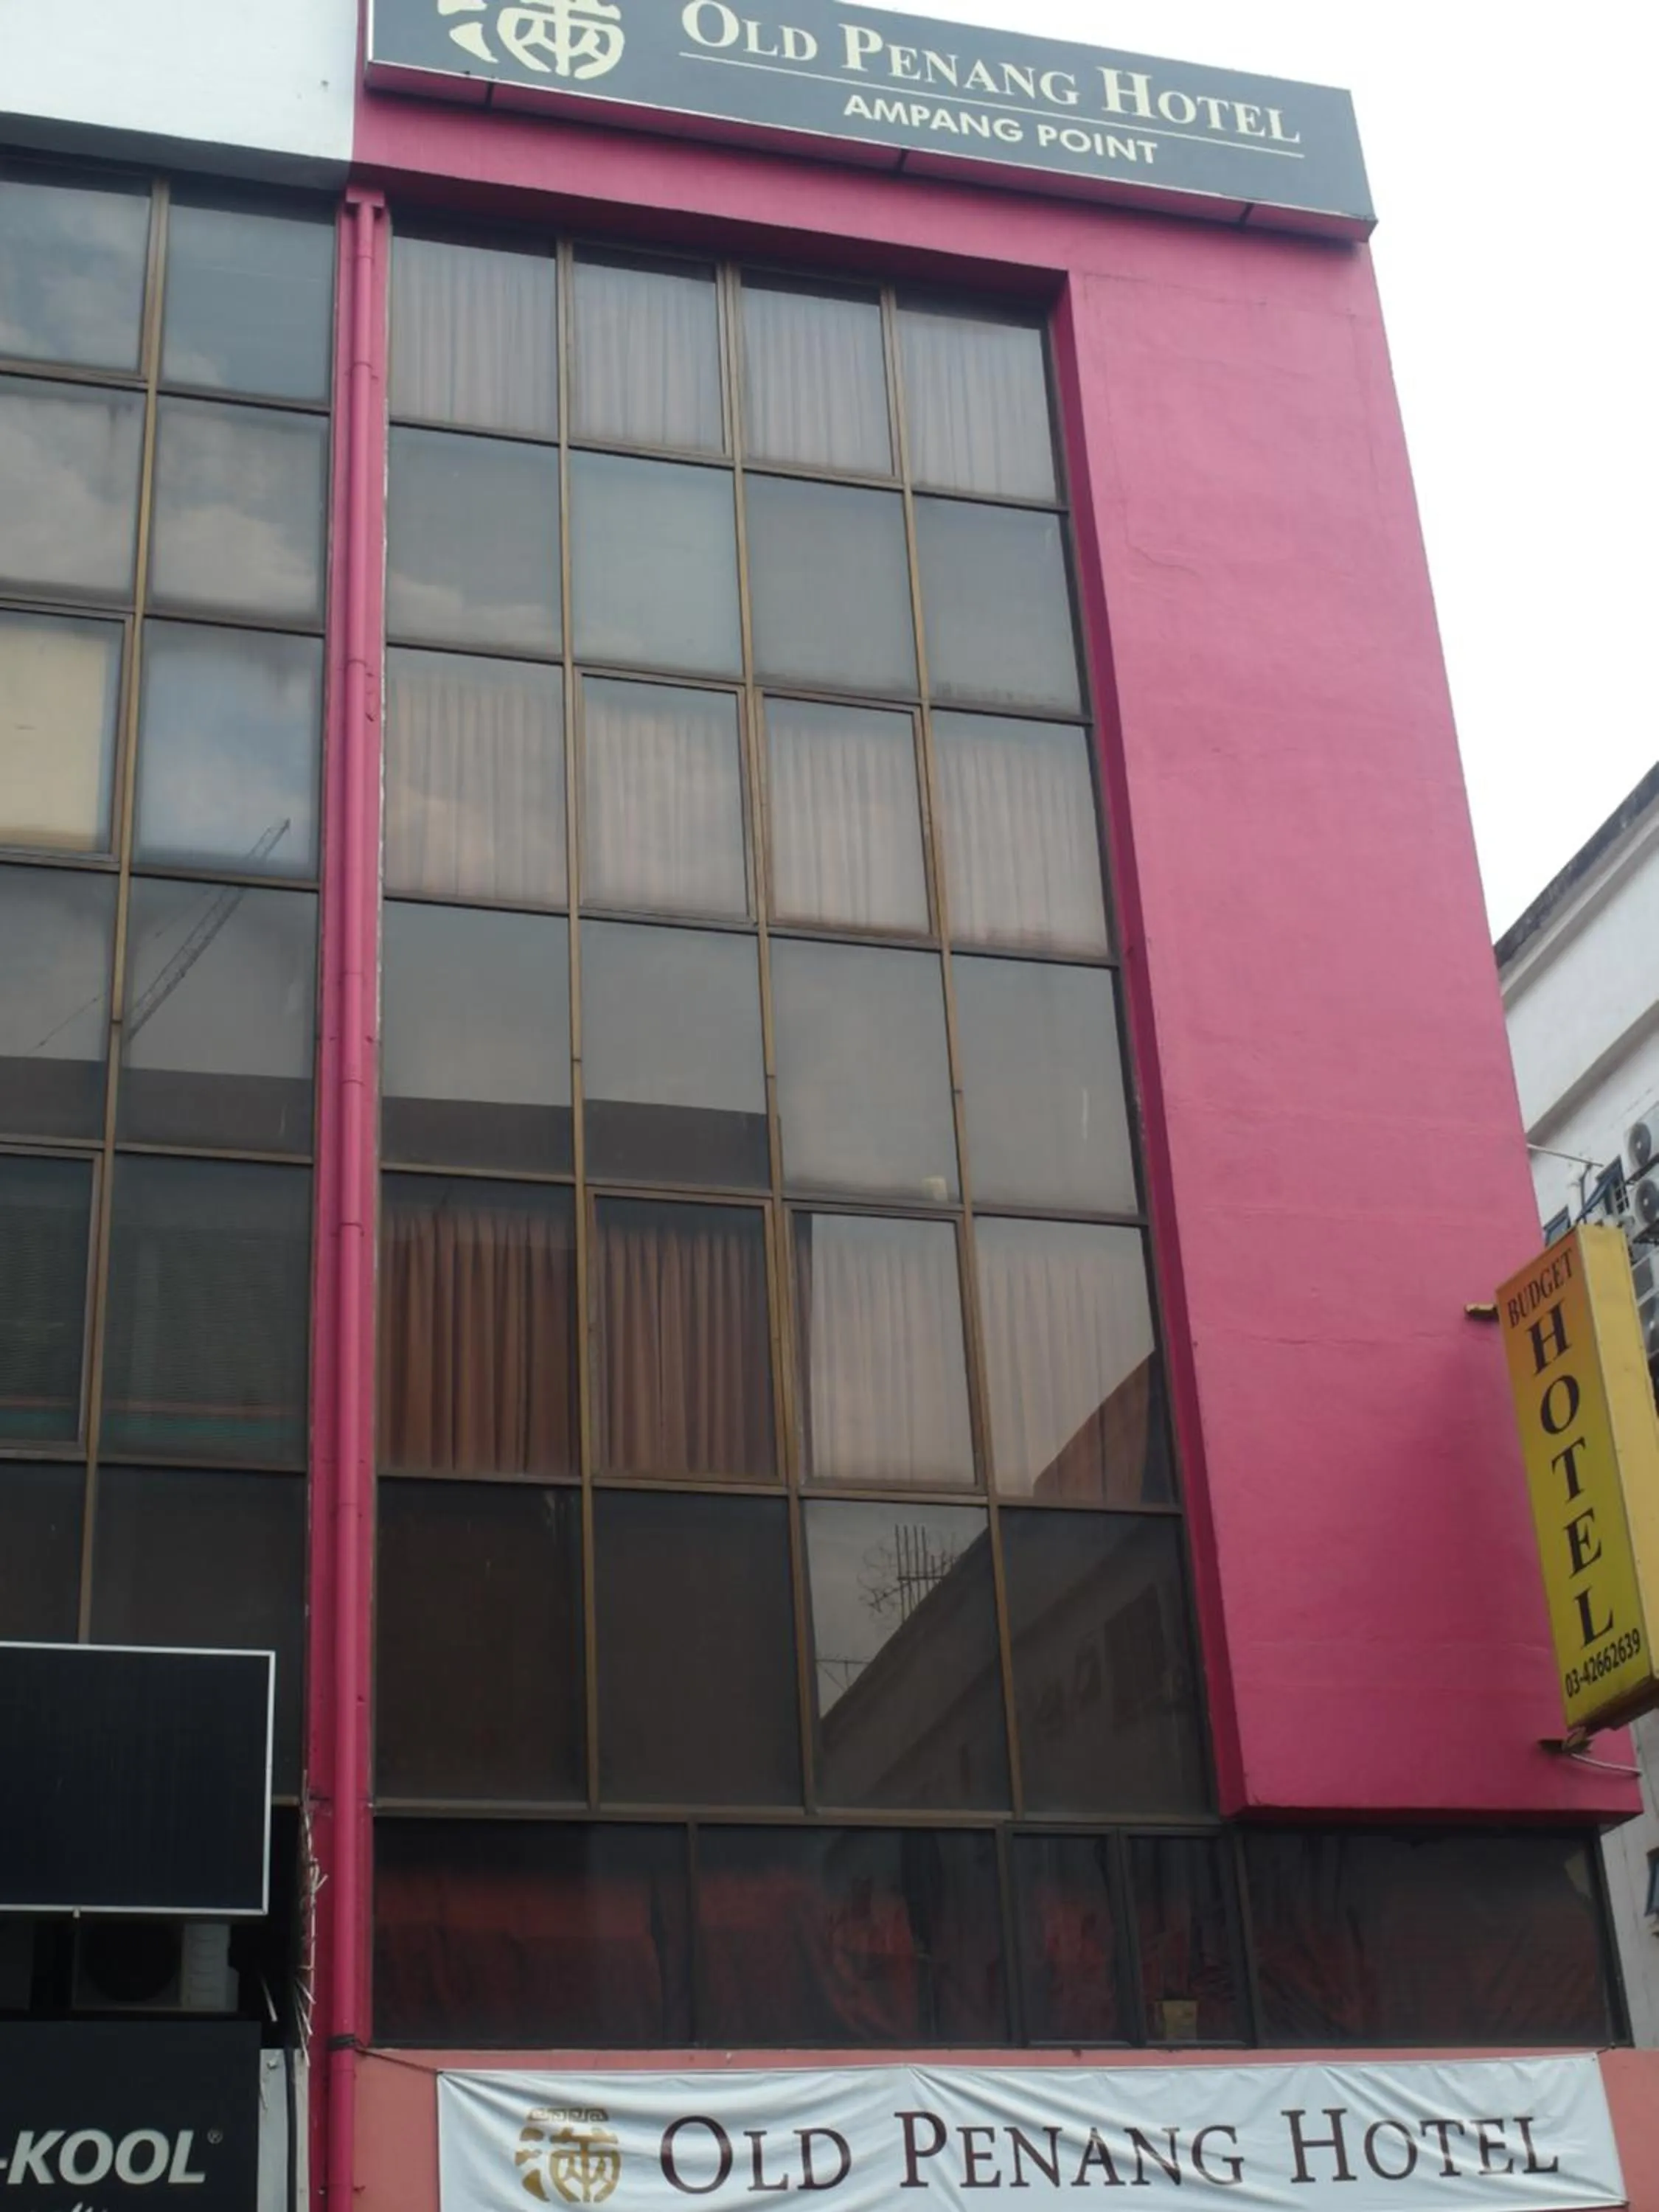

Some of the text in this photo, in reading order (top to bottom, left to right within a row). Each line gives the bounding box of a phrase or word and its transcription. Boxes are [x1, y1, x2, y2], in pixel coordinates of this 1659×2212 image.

[682, 0, 817, 60] OLD
[839, 24, 1079, 105] PENANG
[1096, 66, 1300, 142] HOTEL
[844, 94, 1158, 164] AMPANG POINT
[1507, 1247, 1572, 1328] BUDGET
[1526, 1298, 1614, 1649] HOTEL
[1565, 1627, 1641, 1698] 03-42662639
[660, 2107, 1559, 2194] OLD PENANG HOTEL
